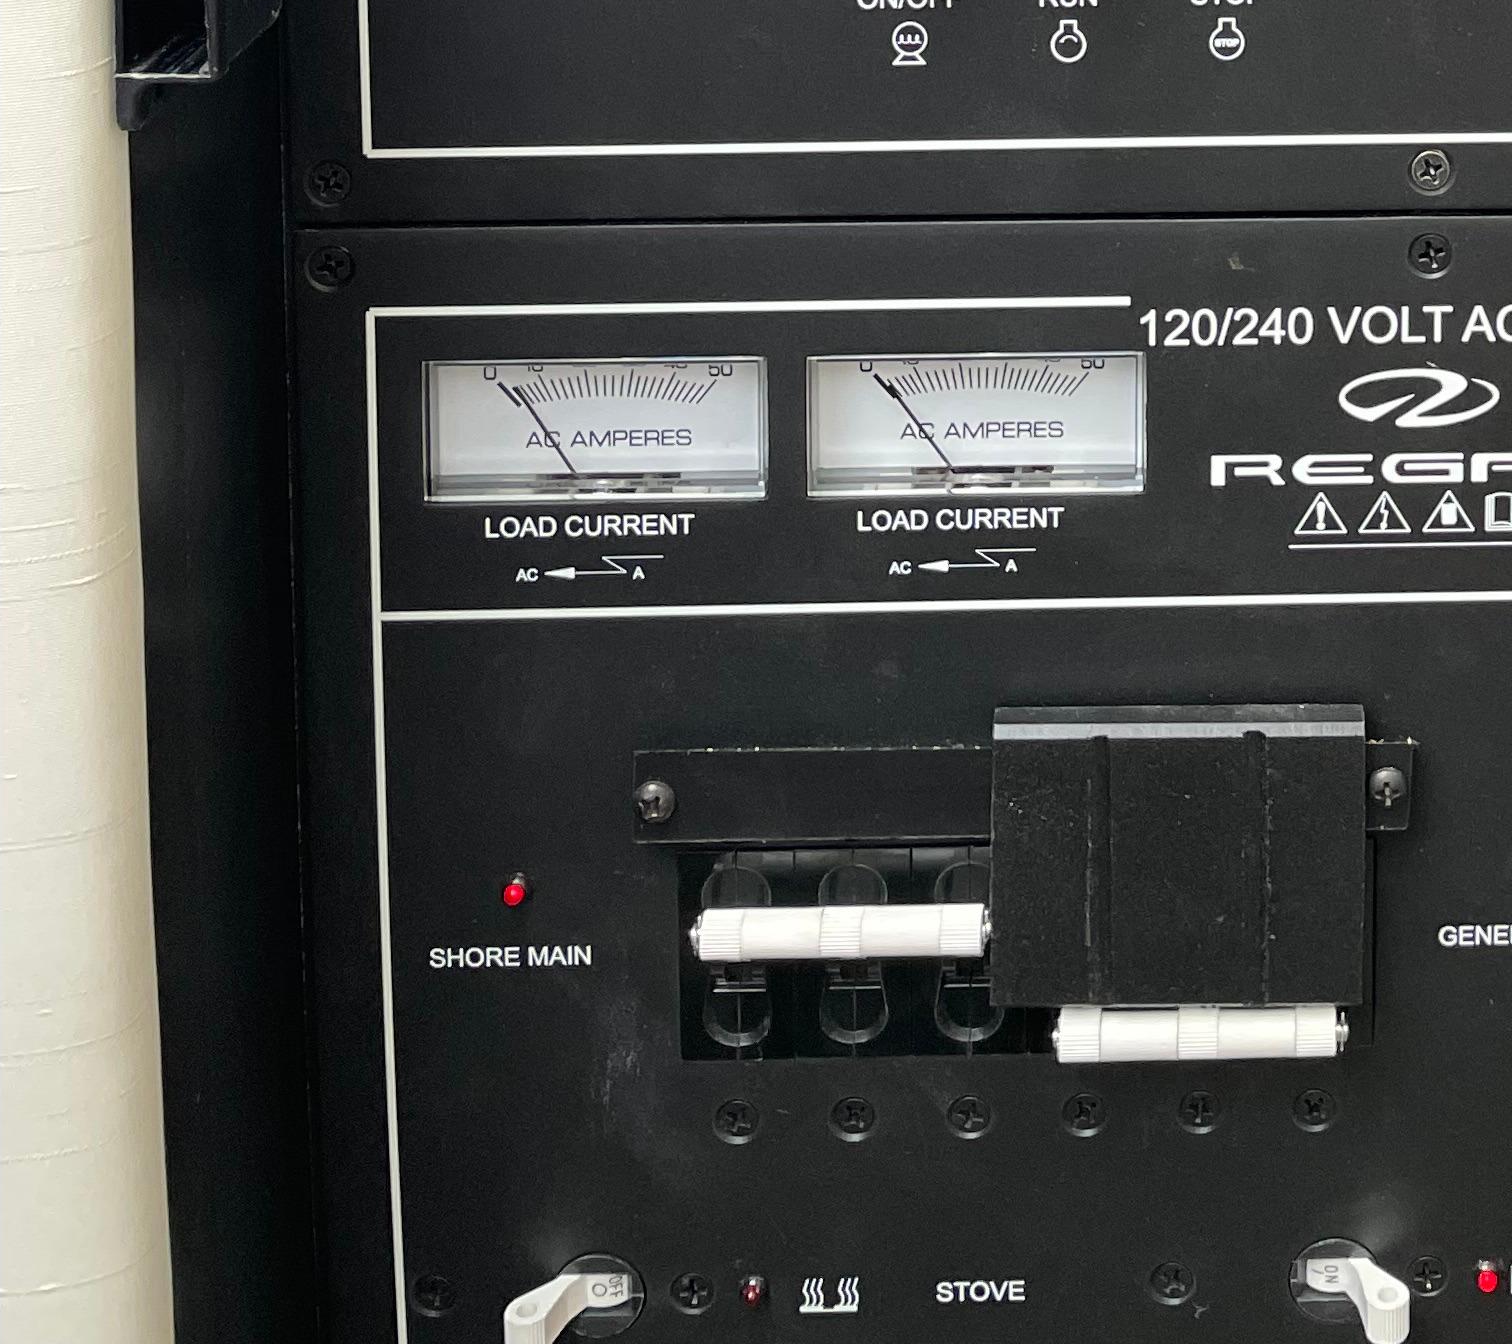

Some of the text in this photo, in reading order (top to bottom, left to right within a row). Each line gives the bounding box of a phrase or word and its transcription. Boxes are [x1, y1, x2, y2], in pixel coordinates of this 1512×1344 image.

[1139, 306, 1314, 347] 120/240
[1326, 305, 1454, 344] VOLT
[483, 364, 733, 380] 0 50
[526, 429, 692, 448] AC AMPERES
[901, 421, 1064, 439] AC AMPERES
[484, 513, 696, 539] LOAD CURRENT
[857, 506, 1065, 532] LOAD CURRENT
[515, 565, 646, 582] AC A
[888, 558, 1018, 575] AC A
[429, 944, 592, 969] SHORE MAIN
[935, 1280, 1026, 1303] STOVE
